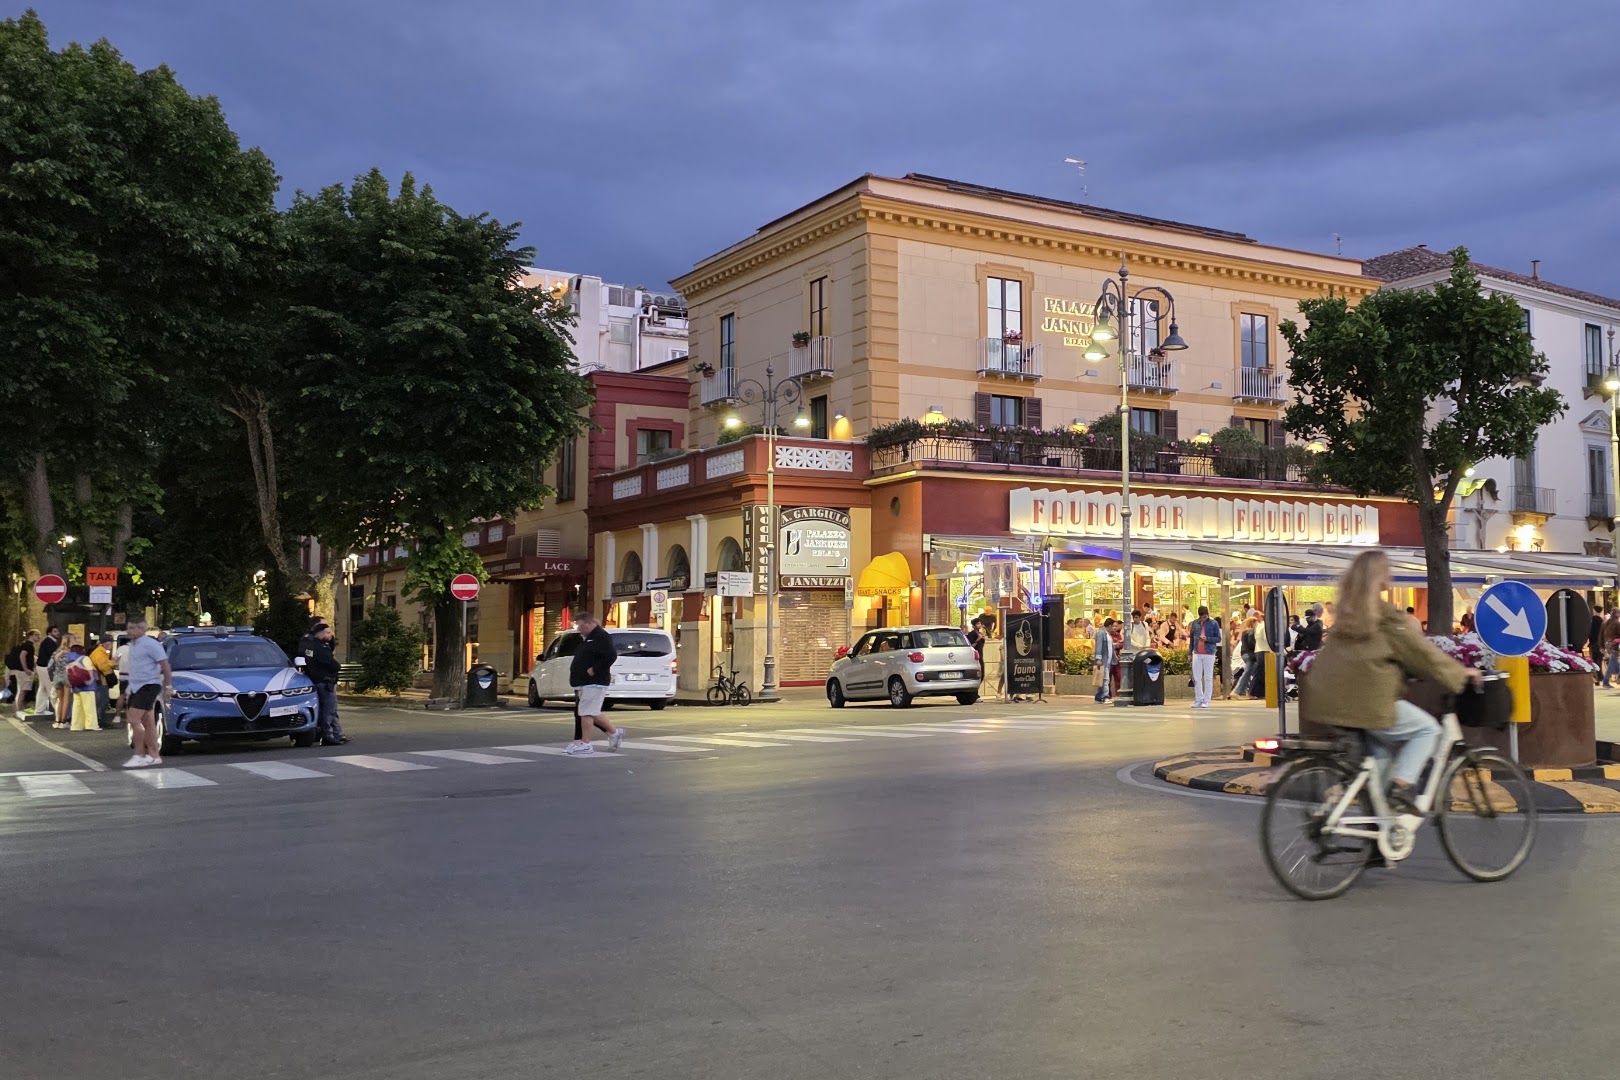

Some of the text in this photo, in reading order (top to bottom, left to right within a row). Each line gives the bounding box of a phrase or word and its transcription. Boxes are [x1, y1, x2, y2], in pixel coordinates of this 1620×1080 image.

[793, 508, 849, 525] GARGIULO
[1033, 500, 1184, 530] FAUNO BAR
[1237, 509, 1363, 535] FAUNO BAR
[544, 562, 570, 571] LACE
[89, 572, 116, 581] TAXI
[787, 577, 844, 586] JANNUZZI
[1013, 663, 1036, 676] fauno
